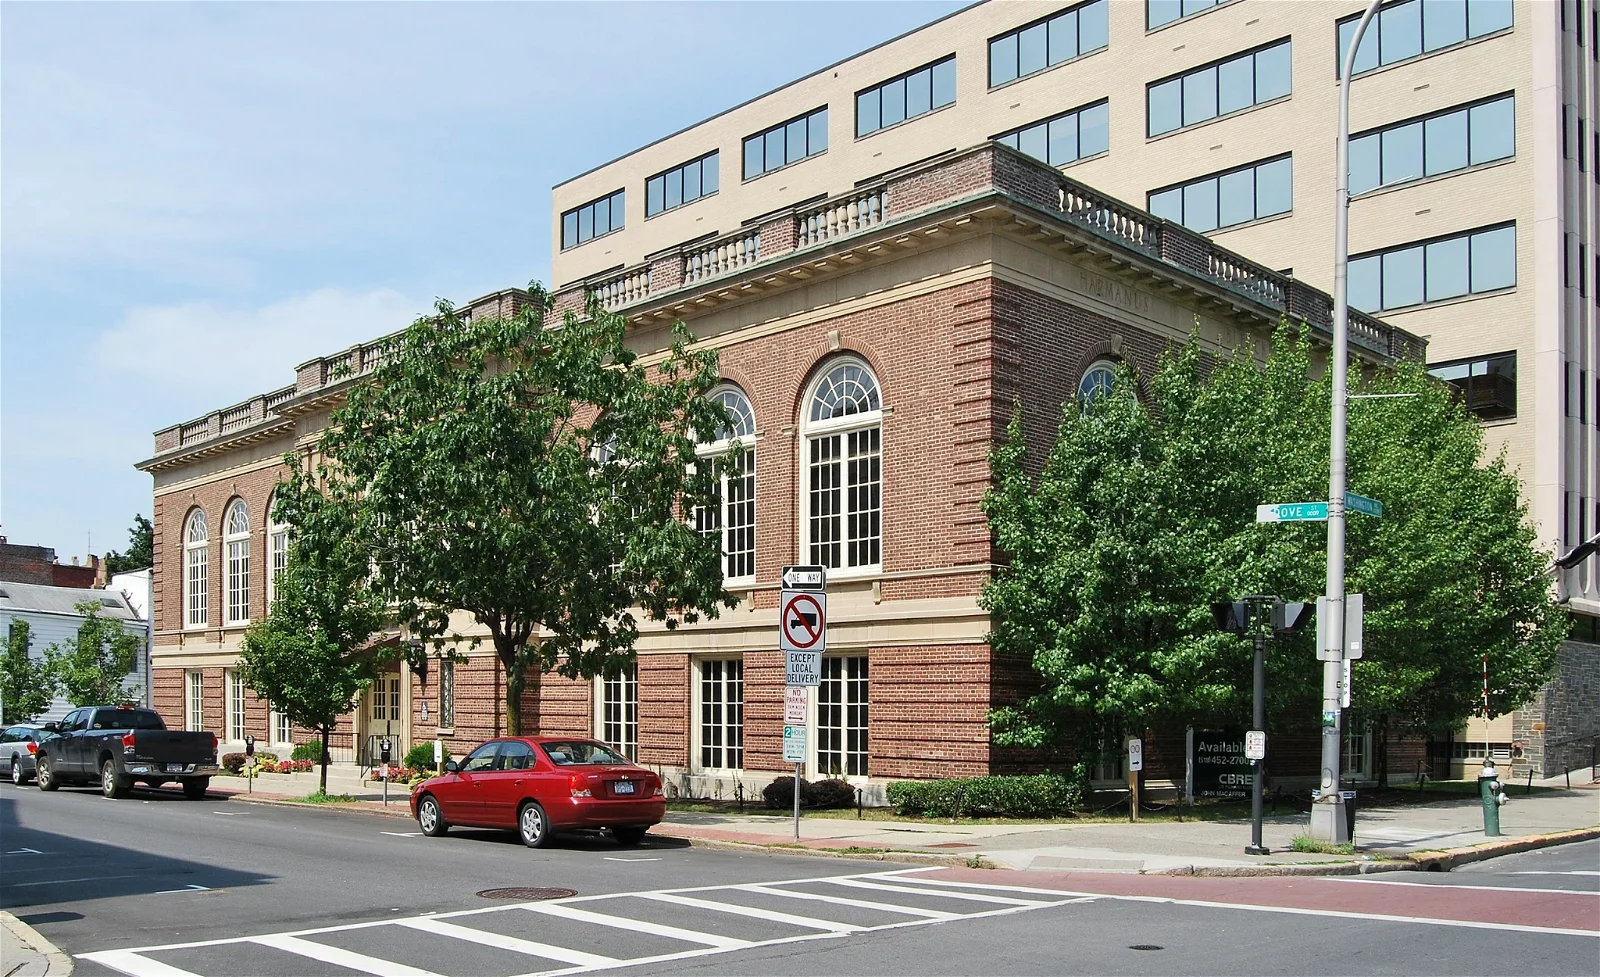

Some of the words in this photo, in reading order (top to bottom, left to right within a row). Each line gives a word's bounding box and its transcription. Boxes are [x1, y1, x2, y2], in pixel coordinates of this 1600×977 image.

[1080, 271, 1149, 312] HARMANUS
[788, 573, 800, 583] ONE
[807, 573, 820, 582] WAY
[790, 653, 816, 663] EXCEPT
[791, 663, 813, 673] LOCAL
[787, 673, 819, 683] DELIVERY
[785, 728, 790, 737] 2
[792, 729, 806, 737] HOUR
[1219, 774, 1253, 785] CBRE
